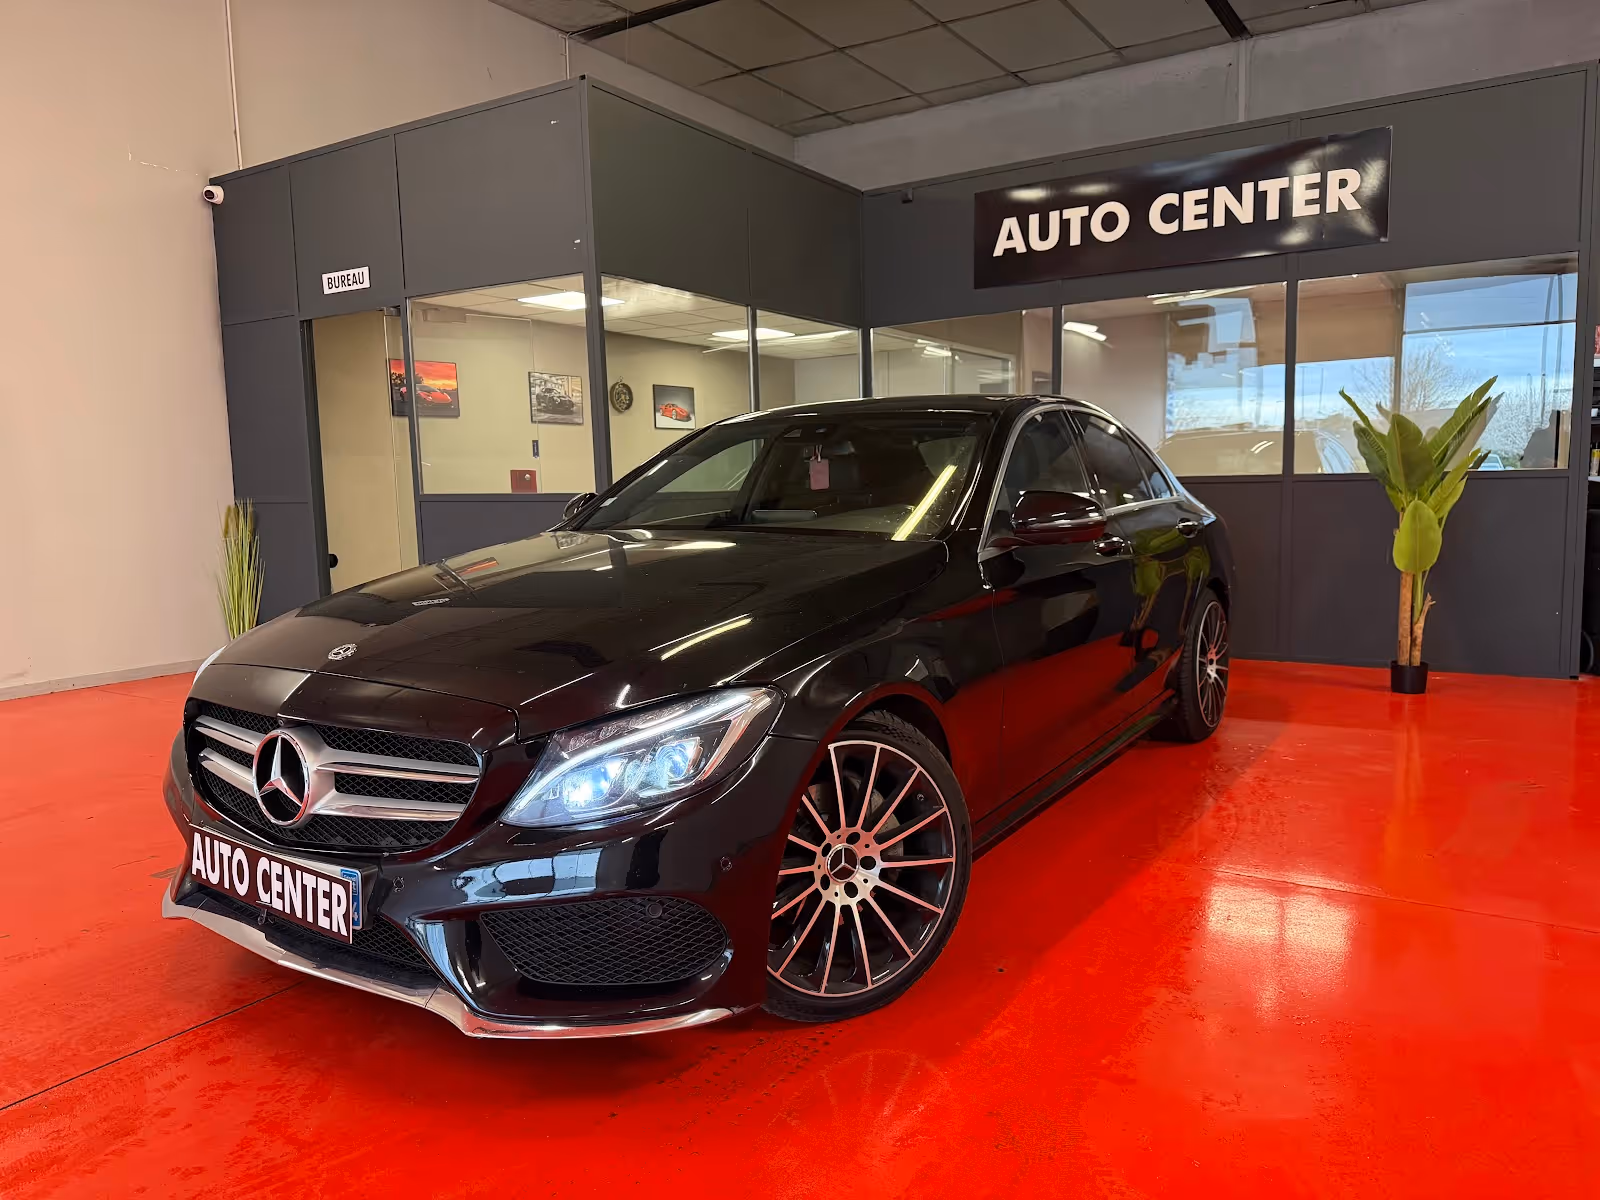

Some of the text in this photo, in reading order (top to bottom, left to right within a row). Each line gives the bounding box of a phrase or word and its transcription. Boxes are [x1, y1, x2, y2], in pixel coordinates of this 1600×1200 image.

[992, 168, 1362, 257] AUTO CENTER
[327, 271, 365, 290] BUREAU
[191, 831, 348, 937] AUTO CENTER
